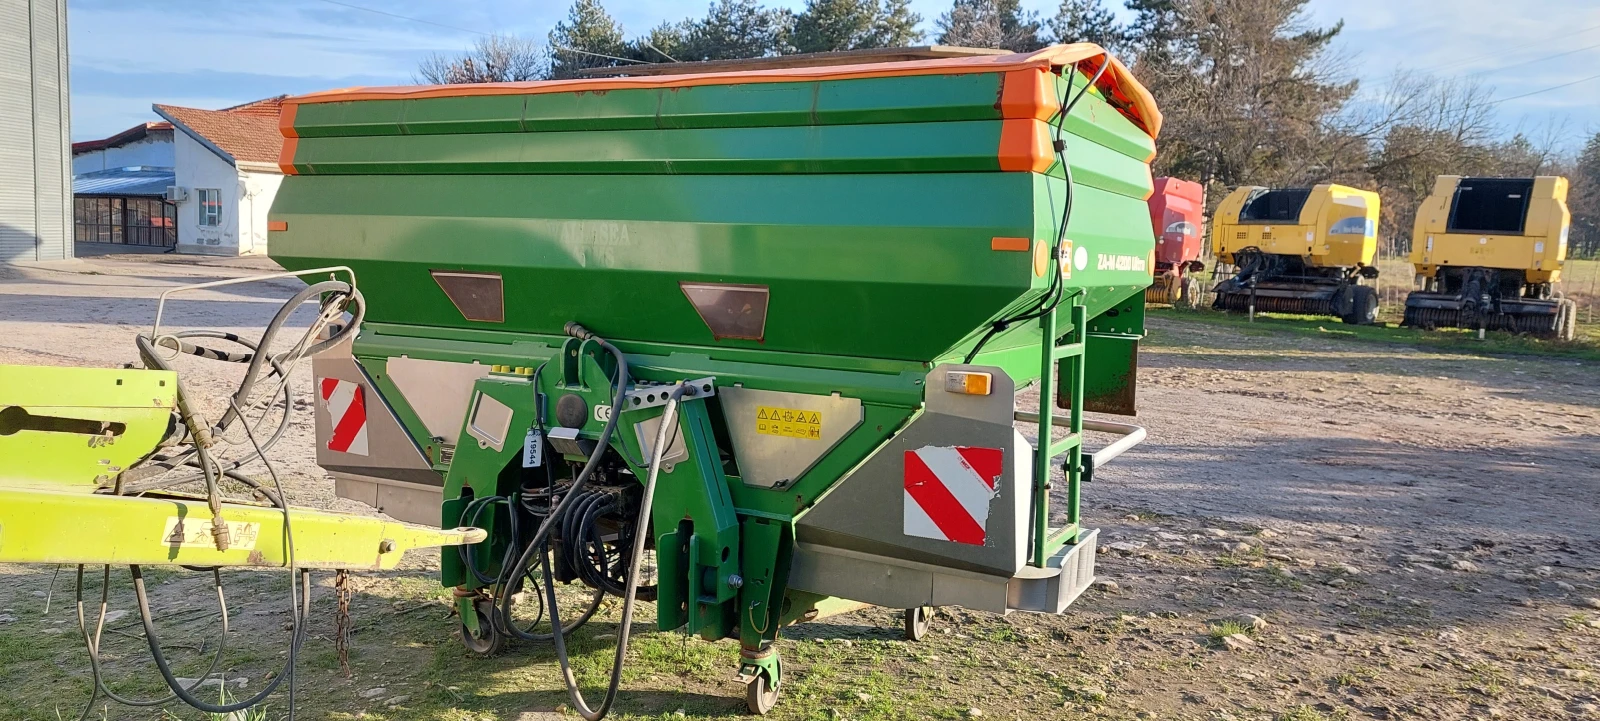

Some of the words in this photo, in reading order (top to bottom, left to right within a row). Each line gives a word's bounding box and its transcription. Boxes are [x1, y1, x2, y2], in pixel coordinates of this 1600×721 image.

[1097, 253, 1115, 270] ZA-M
[1115, 255, 1131, 271] 4200
[597, 407, 611, 419] CE
[529, 439, 537, 465] 19544
